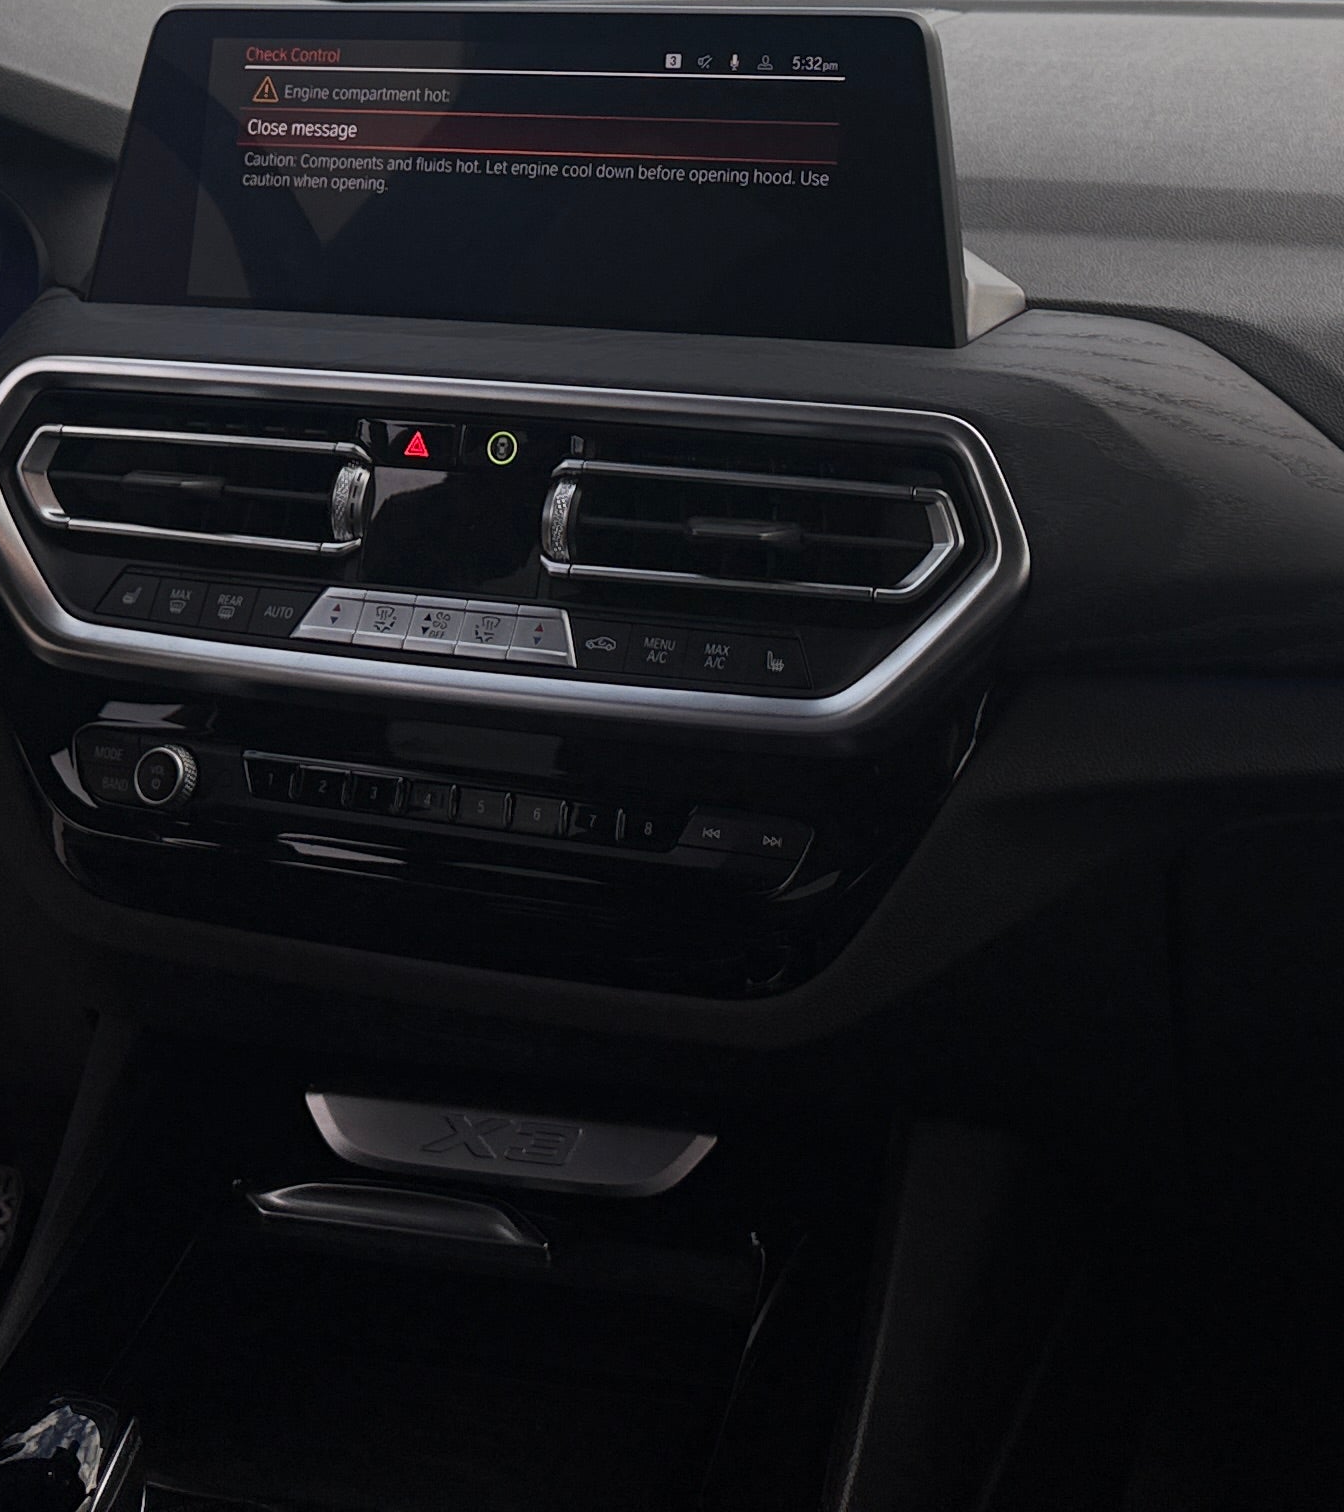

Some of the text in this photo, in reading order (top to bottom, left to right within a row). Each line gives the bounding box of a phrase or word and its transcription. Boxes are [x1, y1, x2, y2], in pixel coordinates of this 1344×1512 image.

[245, 46, 341, 64] Check Control
[284, 84, 330, 103] Engine
[332, 88, 421, 104] compartment
[247, 118, 358, 142] Close message
[244, 151, 831, 187] Caution: Components and fluids hot. Let engine cool down before opening hood. Use
[242, 172, 389, 194] caution when opening.
[170, 588, 193, 601] MAX
[217, 593, 245, 607] REAR
[264, 605, 295, 620] AUTO
[643, 636, 676, 652] MENU
[704, 642, 731, 657] MAX
[646, 650, 669, 664] A/C
[703, 655, 727, 670] A/C
[94, 745, 126, 761] MODE
[318, 779, 328, 793] 2
[369, 786, 379, 800] 3
[476, 800, 485, 814] 5
[532, 807, 542, 821] 6
[643, 820, 654, 836] 8
[421, 1113, 584, 1167] X3
